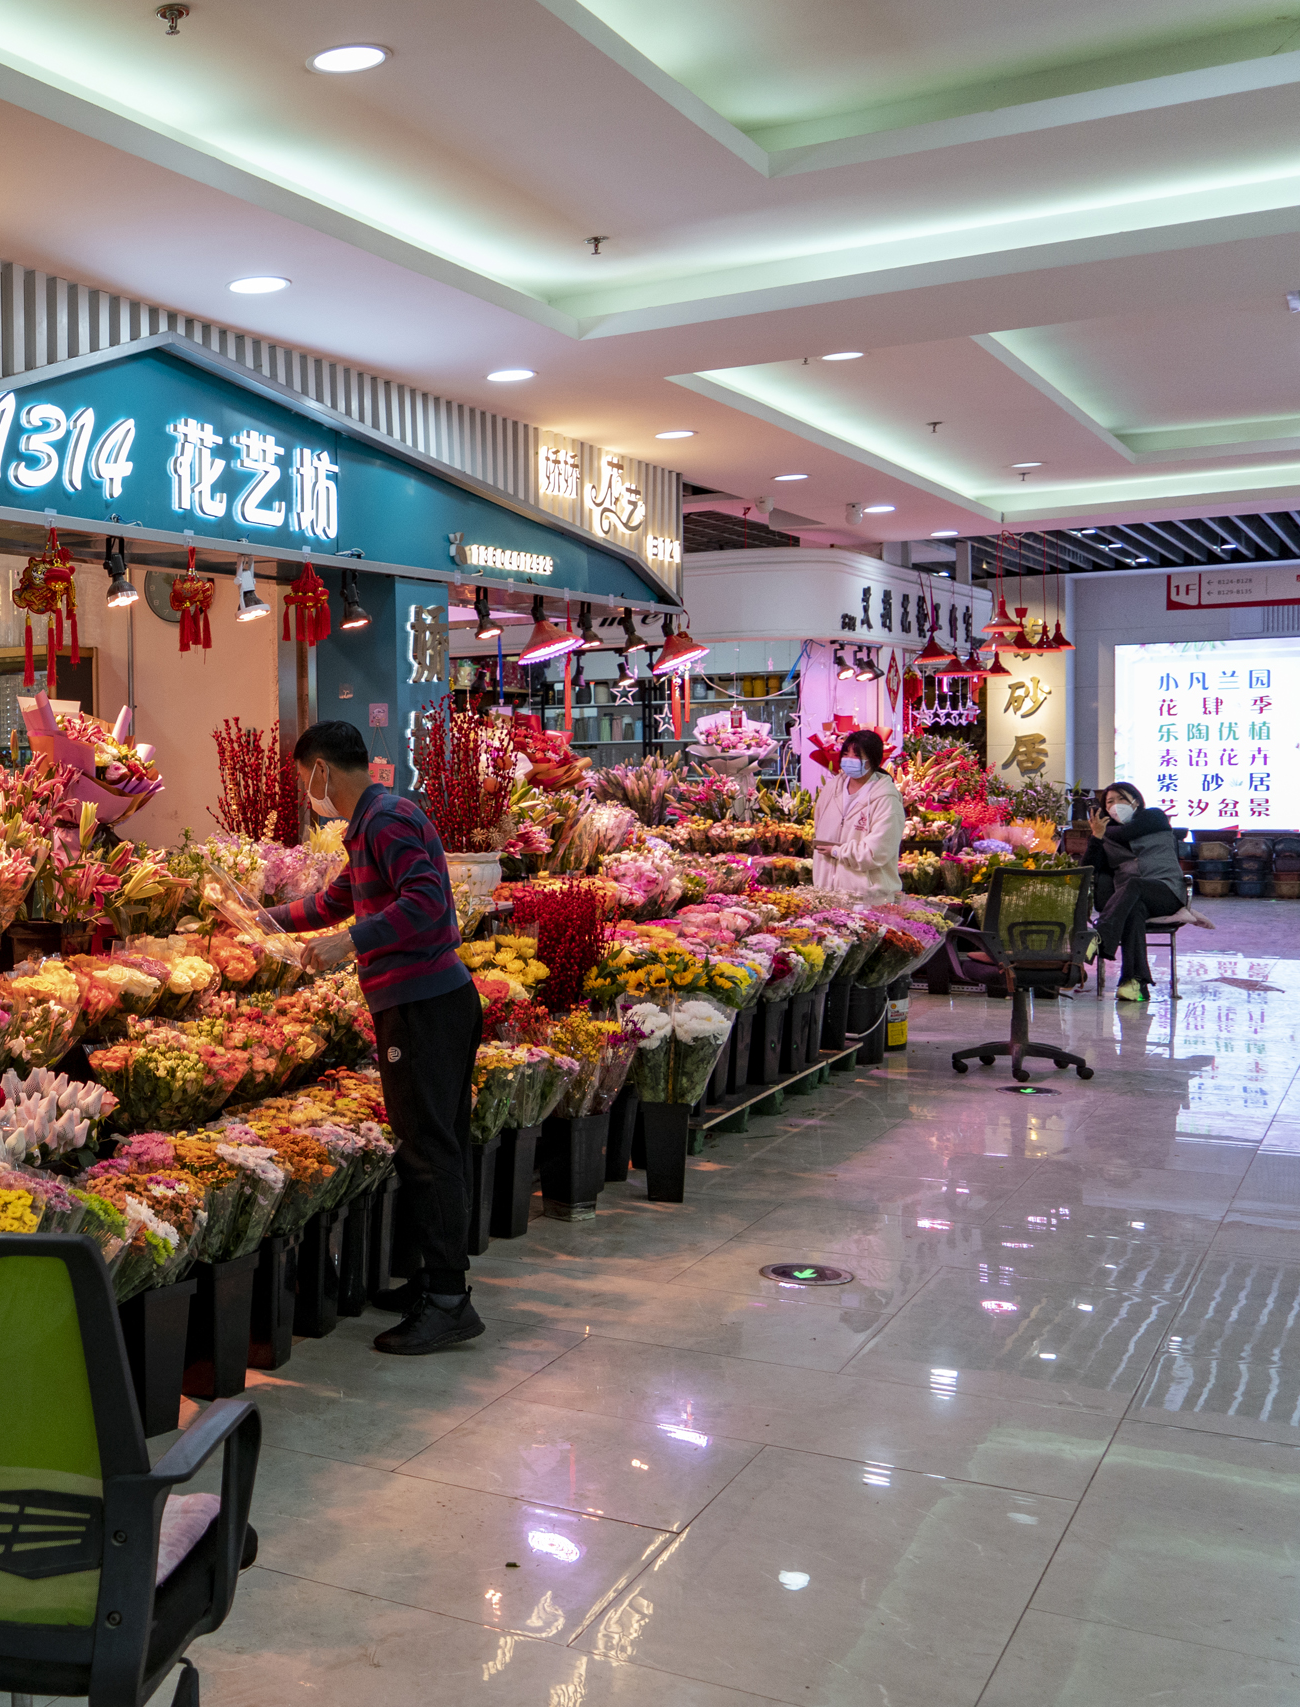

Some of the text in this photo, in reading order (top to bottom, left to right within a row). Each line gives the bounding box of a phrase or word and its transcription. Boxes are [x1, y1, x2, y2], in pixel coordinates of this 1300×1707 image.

[167, 417, 339, 540] 花艺坊
[542, 447, 580, 498] 娇娇
[1173, 583, 1197, 597] 1F
[1158, 669, 1271, 691] 小凡兰园
[1158, 695, 1273, 717] 花肆季
[1158, 721, 1271, 742] 乐陶优植
[1158, 747, 1270, 767] 素语花卉
[1157, 772, 1271, 792] 紫砂居
[1157, 798, 1271, 817] 艺汐盆景
